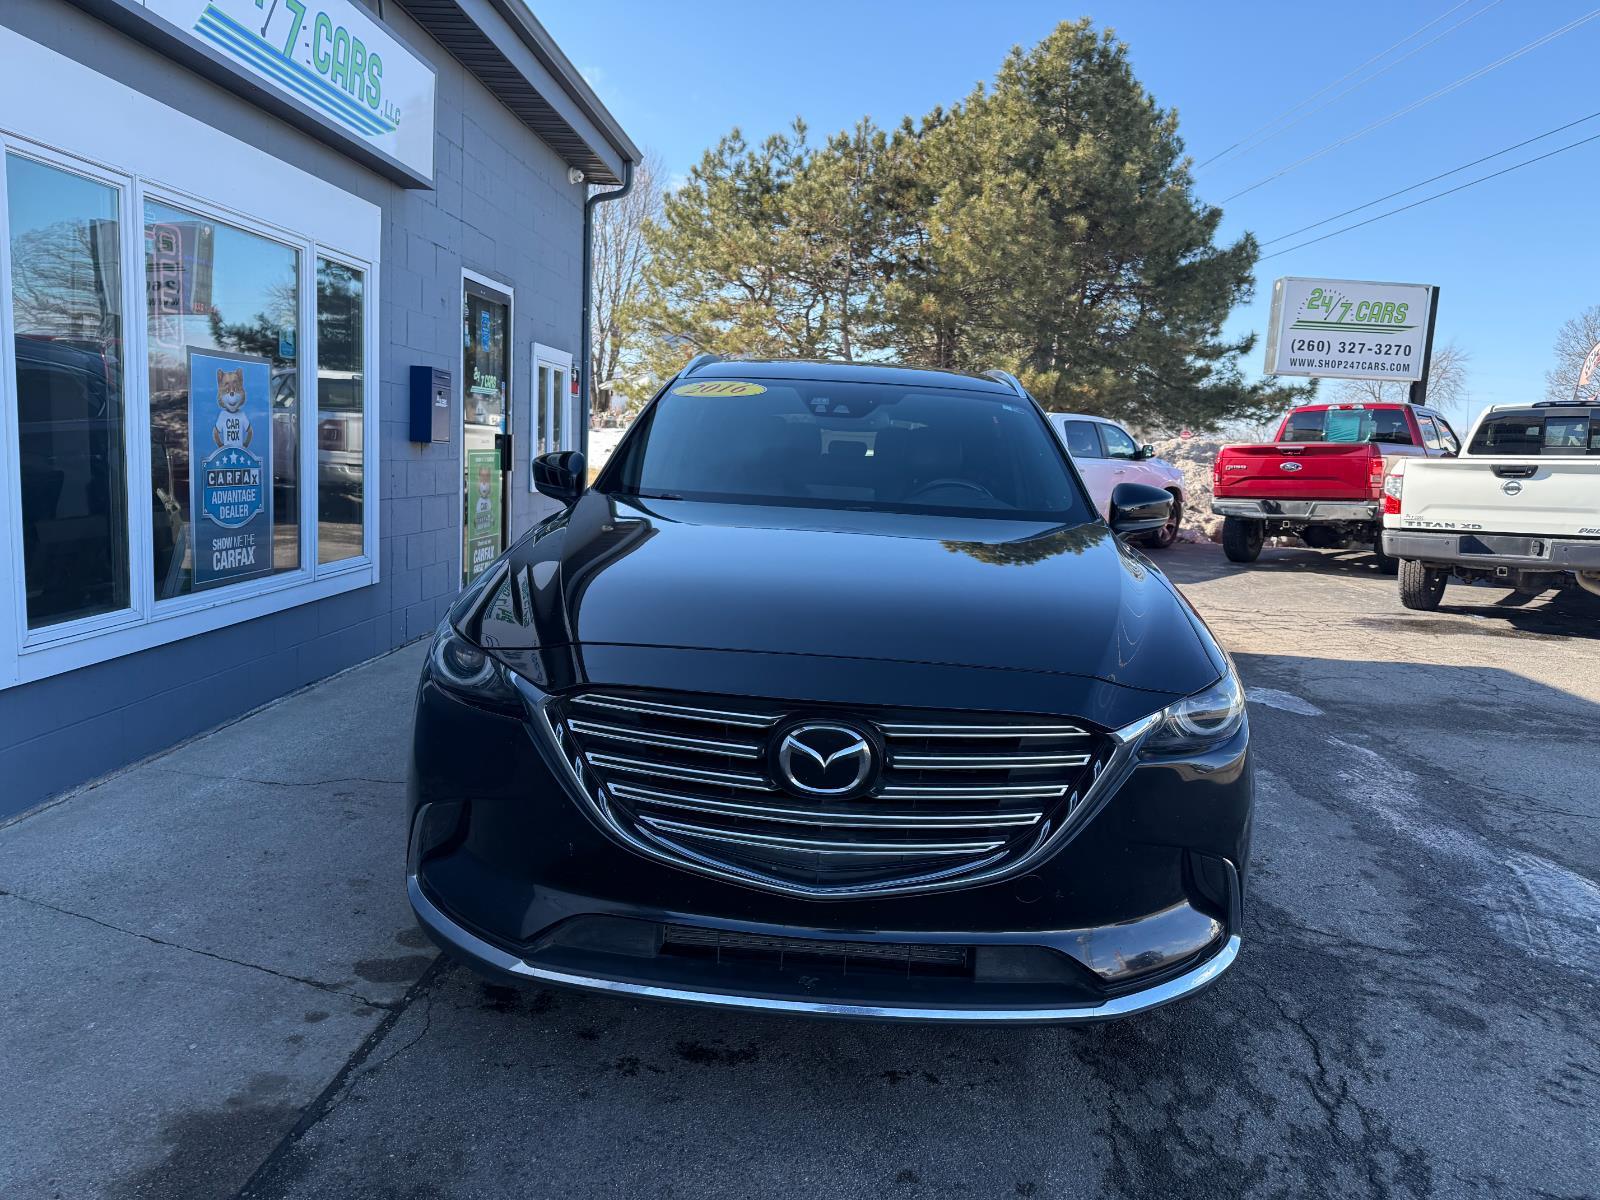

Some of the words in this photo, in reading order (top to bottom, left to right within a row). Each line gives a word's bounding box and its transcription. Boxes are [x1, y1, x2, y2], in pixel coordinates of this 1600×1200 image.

[1355, 300, 1409, 324] CARS
[1291, 339, 1331, 355] (260)
[1338, 341, 1412, 357] 327-3270
[1289, 357, 1411, 373] WWW.SHOP247CARS.COM
[684, 383, 749, 394] 2016
[226, 418, 240, 430] CAR
[227, 430, 240, 442] FOX
[208, 471, 259, 486] CARFAX
[211, 488, 256, 505] ADVANTAGE
[219, 504, 249, 520] DEALER
[1404, 520, 1456, 529] TITAN
[212, 537, 233, 551] SHOW
[233, 536, 243, 547] ME
[243, 533, 255, 546] THE
[212, 546, 257, 571] CARFAX
